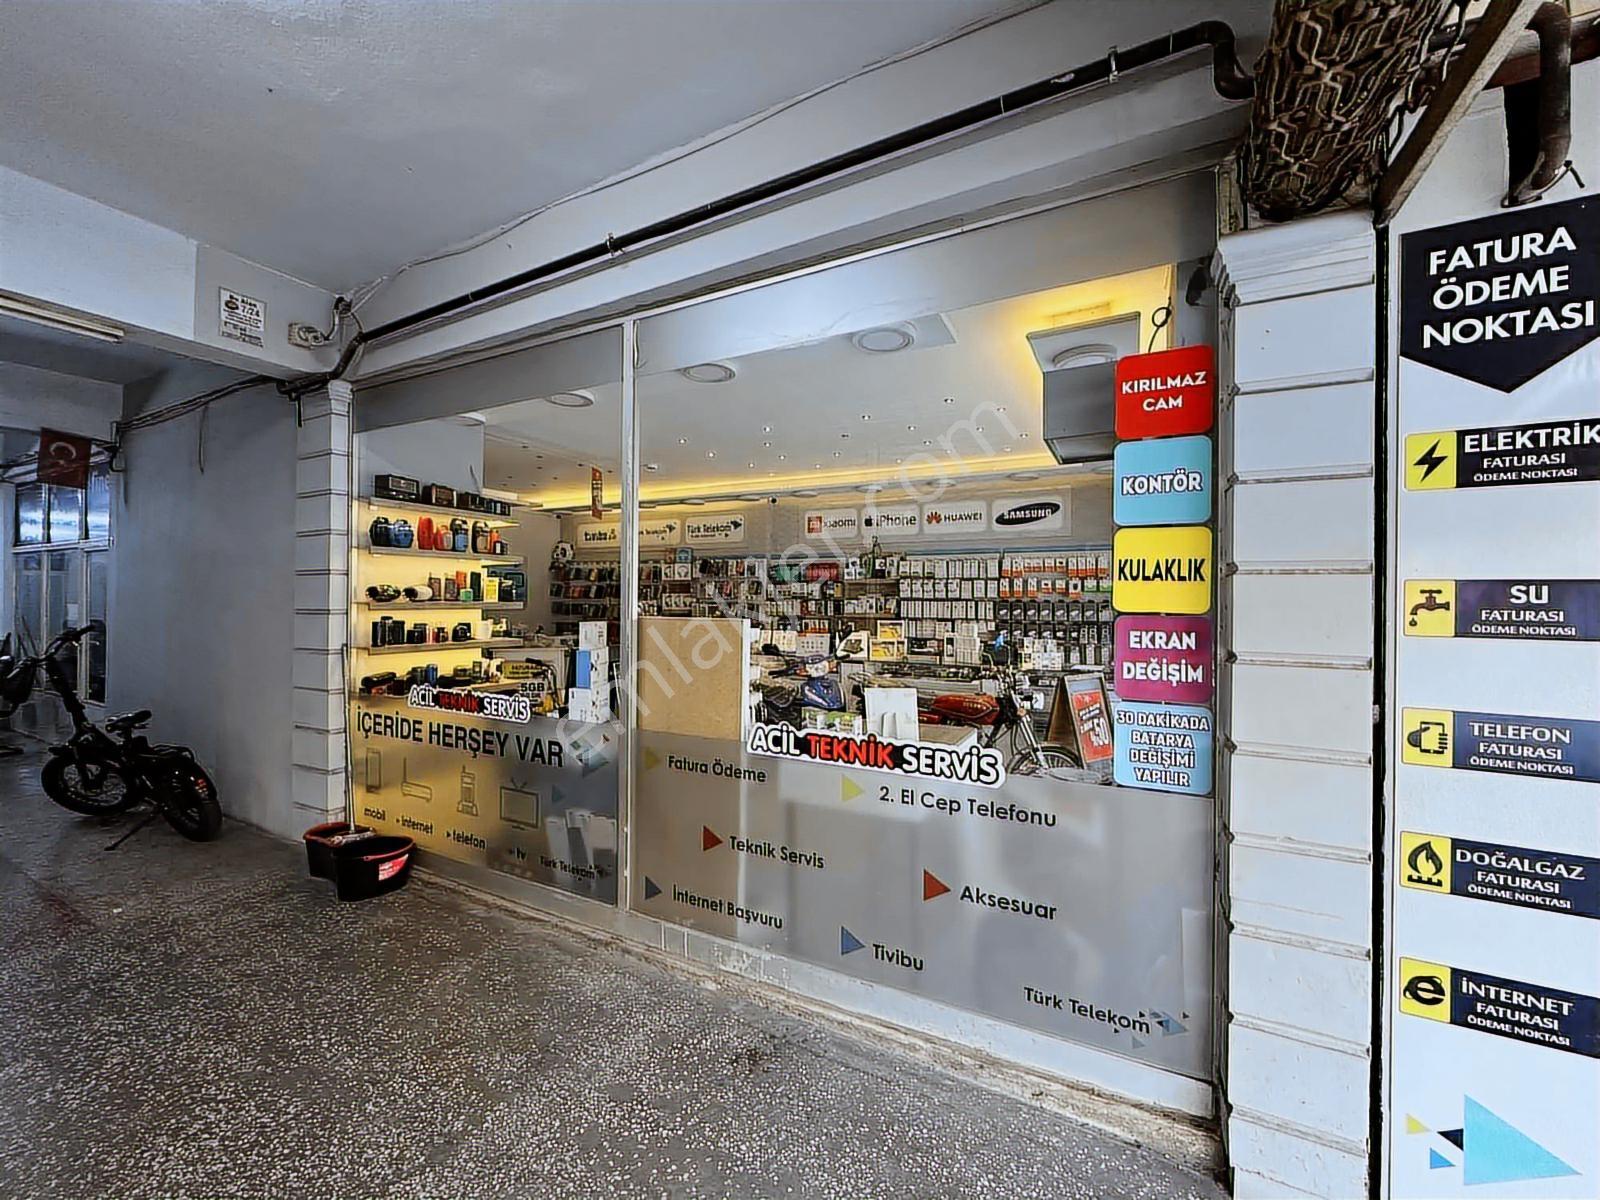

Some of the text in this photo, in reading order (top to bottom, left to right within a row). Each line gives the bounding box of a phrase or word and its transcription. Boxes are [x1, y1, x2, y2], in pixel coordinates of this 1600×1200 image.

[1429, 226, 1577, 276] FATURA
[1433, 265, 1569, 310] ÖDEME
[1423, 300, 1595, 349] NOKTASI
[1122, 371, 1207, 395] KIRILMAZ
[1142, 395, 1183, 412] CAM
[1464, 422, 1600, 453] ELEKTRİK
[1483, 453, 1566, 469] FATURASI
[1122, 468, 1204, 496] KONTÖR
[1521, 468, 1578, 480] NOKTASI
[875, 513, 918, 527] iPhone
[943, 512, 983, 523] HUAWEI
[1118, 557, 1206, 583] KULAKLIK
[1509, 584, 1549, 605] SU
[1480, 609, 1565, 623] FATURASI
[1128, 630, 1197, 651] EKRAN
[1519, 625, 1577, 637] NOKTASI
[1122, 658, 1204, 687] DEĞİŞİM
[411, 687, 436, 706] ACİL
[483, 695, 528, 720] SERVİS
[1117, 710, 1134, 726] 30
[1137, 710, 1210, 732] DAKİKADA
[1468, 721, 1571, 745] TELEFON
[357, 704, 564, 768] İÇERİDE HERŞEY VAR
[1131, 731, 1195, 749] BATARYA
[751, 723, 999, 784] ACİL TEKNİK SERVİS
[1479, 742, 1563, 760] FATURASI
[668, 755, 767, 783] Fatura Ödeme
[1135, 767, 1191, 787] YAPILIR
[1517, 761, 1574, 775] NOKTASI
[364, 807, 386, 821] mobil
[879, 785, 1058, 828] 2. El Cep Telefonu
[401, 815, 434, 835] internet
[452, 829, 486, 850] telefon
[516, 848, 528, 860] tv
[729, 835, 825, 869] Teknik Servis
[1456, 848, 1586, 881] DOĞALGAZ
[1477, 870, 1560, 894] FATURASI
[959, 884, 1057, 921] Aksesuar
[1515, 893, 1572, 910] NOKTASI
[727, 902, 783, 929] Başvuru
[872, 943, 924, 972] Tivibu
[1461, 976, 1574, 1017] İNTERNET
[1023, 985, 1151, 1035] Türk Telekom
[1476, 1002, 1560, 1031] FATURASI
[1514, 1026, 1571, 1047] NOKTASI
